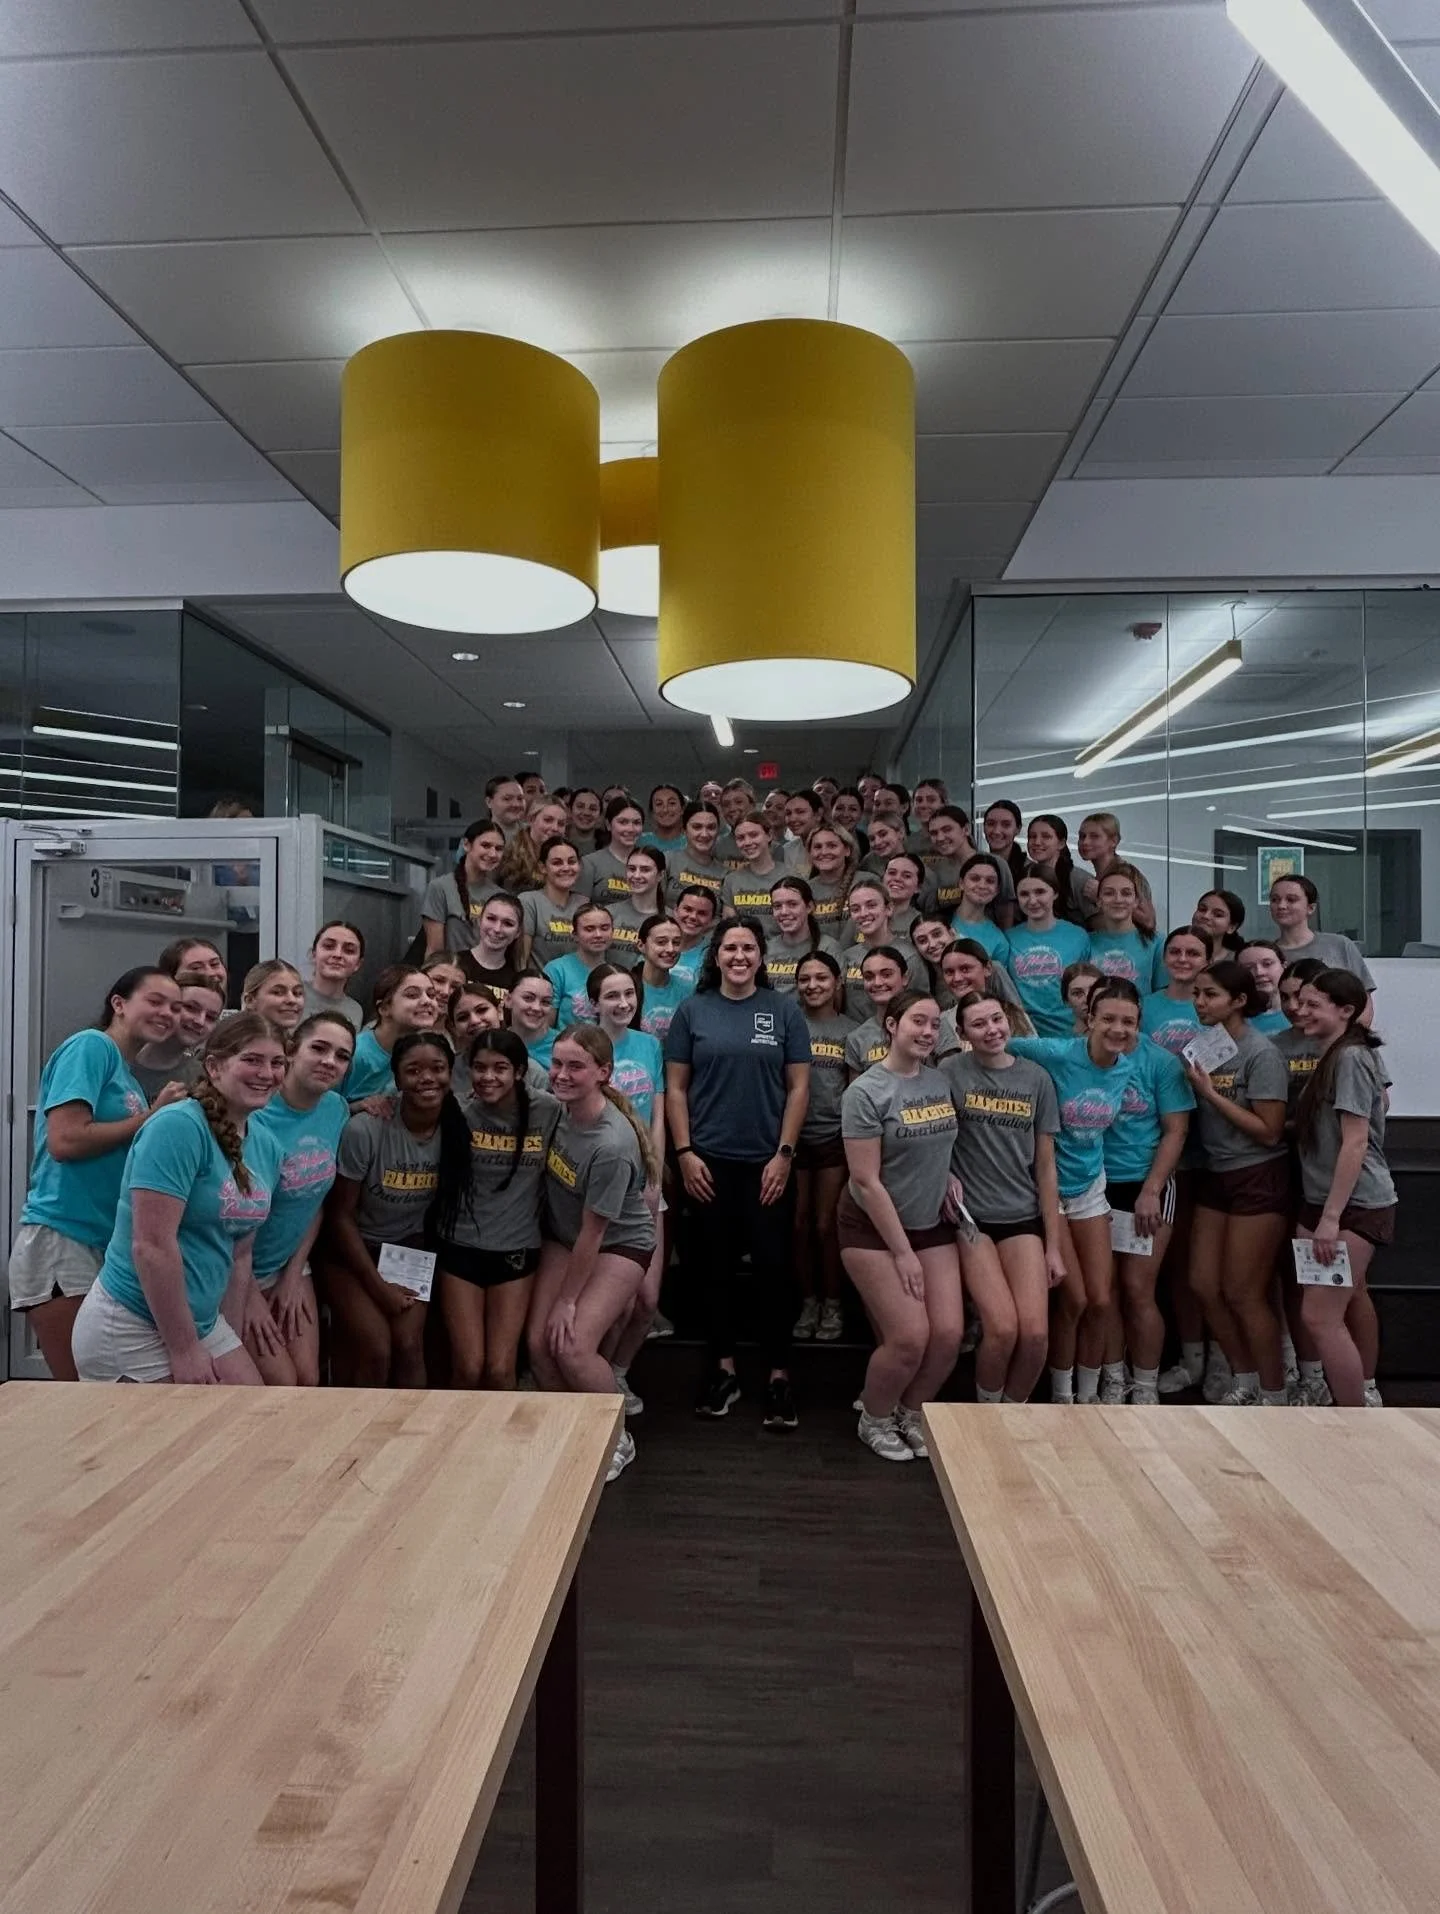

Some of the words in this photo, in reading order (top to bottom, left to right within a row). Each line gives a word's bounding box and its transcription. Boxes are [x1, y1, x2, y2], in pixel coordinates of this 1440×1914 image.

[90, 868, 100, 898] 3
[965, 1093, 1032, 1117] BAMBIES
[471, 1131, 544, 1153] BAMBES
